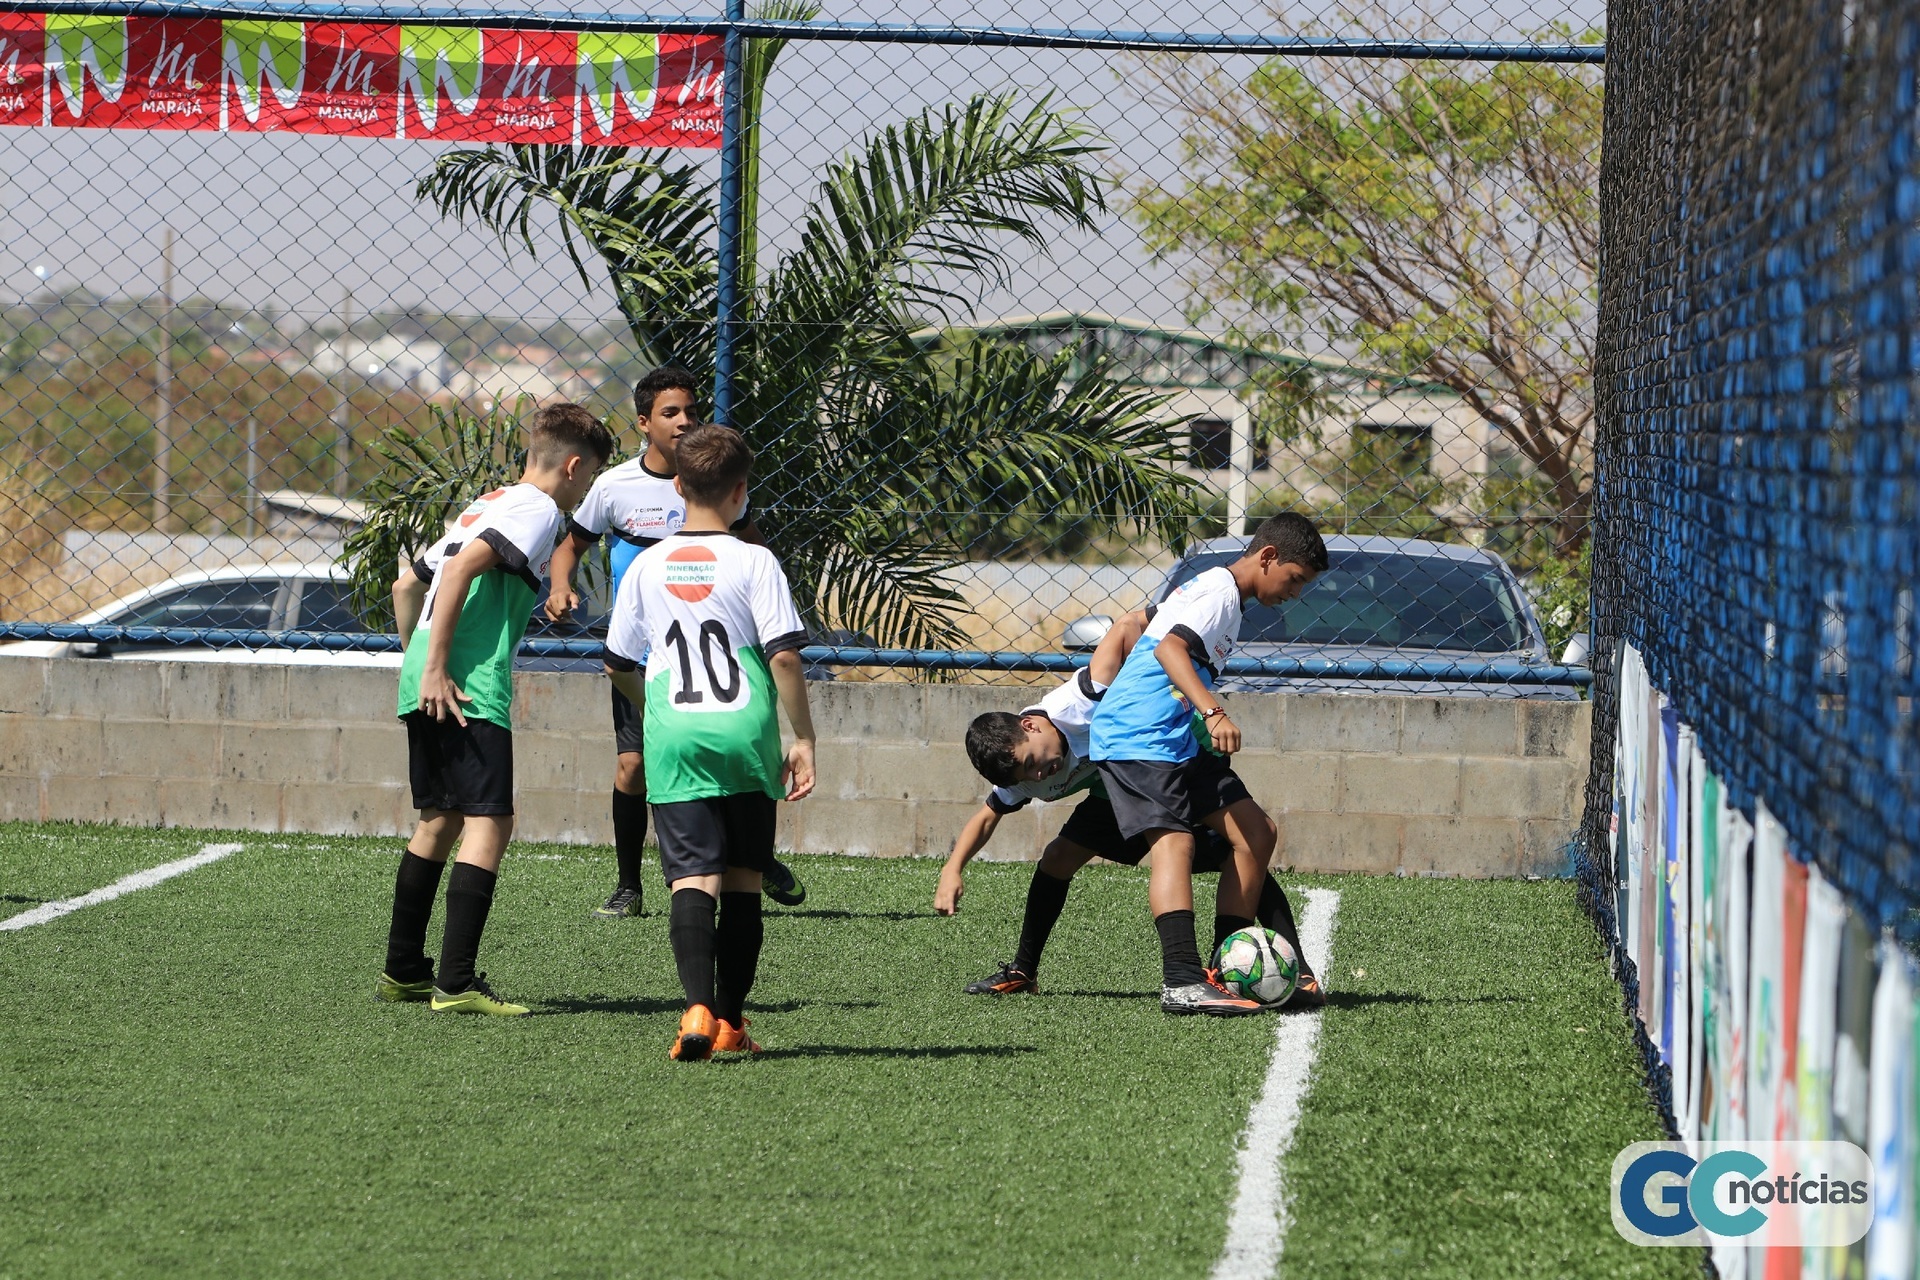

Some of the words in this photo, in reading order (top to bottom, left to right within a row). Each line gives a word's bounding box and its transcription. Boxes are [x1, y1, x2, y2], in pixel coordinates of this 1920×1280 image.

[141, 99, 202, 117] MARAJÁ
[318, 106, 379, 124] MARAJÁ
[495, 113, 556, 130] MARAJÁ
[671, 118, 724, 135] MARAJ
[666, 564, 716, 573] MINERAÇÃO
[666, 575, 715, 583] AEROPORTO
[665, 619, 741, 704] 10
